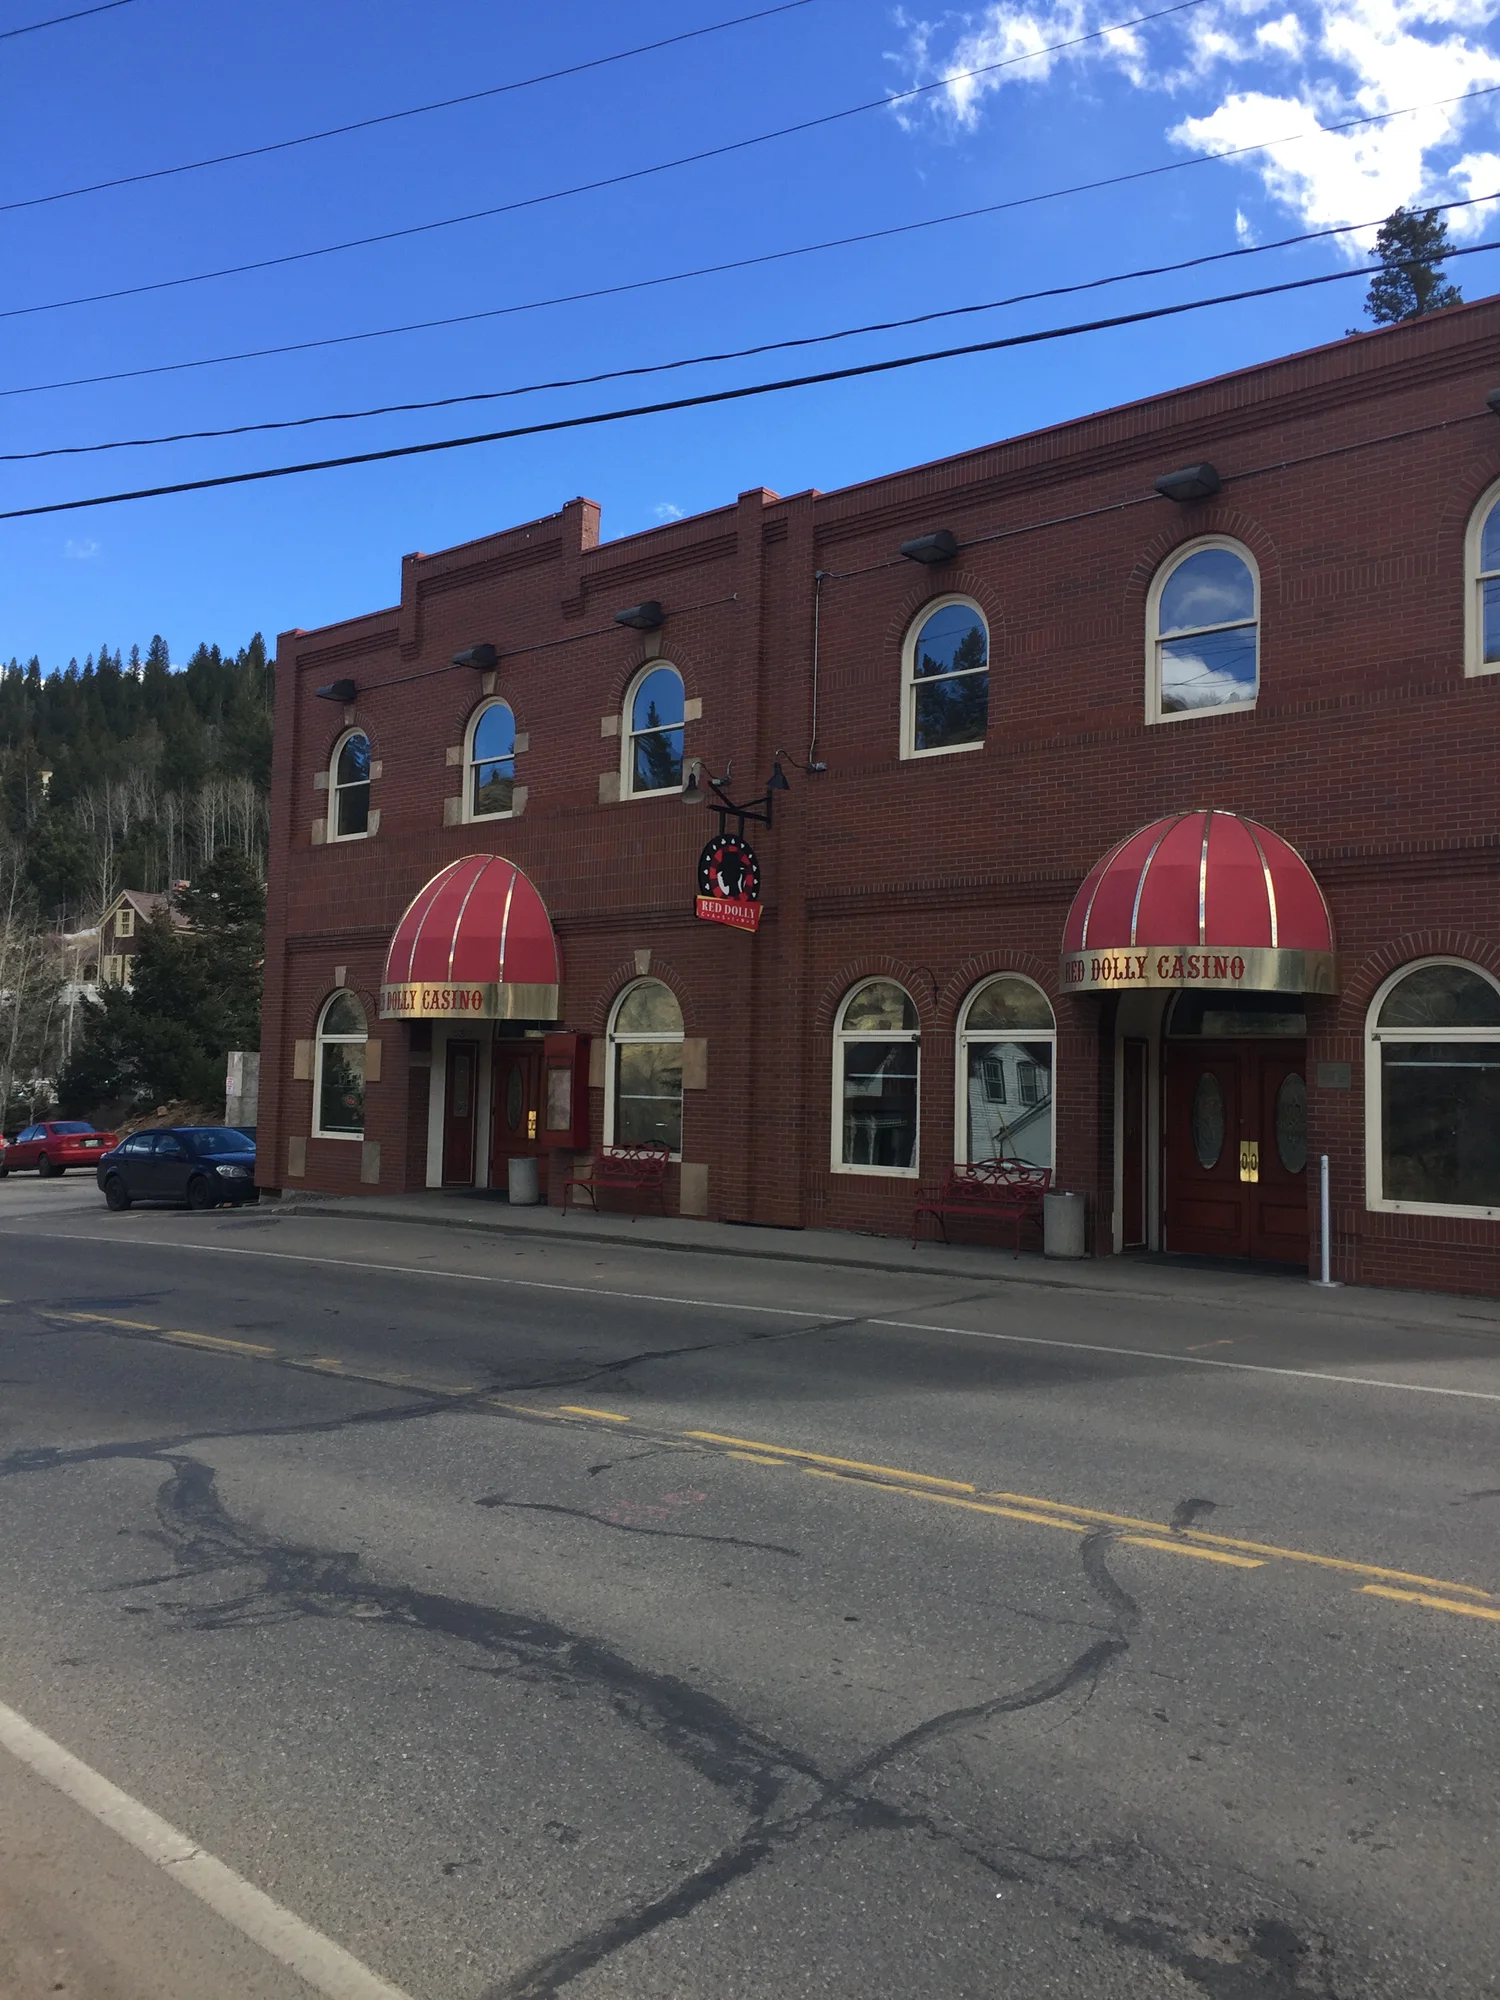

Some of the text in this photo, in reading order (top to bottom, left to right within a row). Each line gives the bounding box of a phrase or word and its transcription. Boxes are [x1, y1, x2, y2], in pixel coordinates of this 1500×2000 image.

[702, 901, 755, 919] RED DOLLY
[1065, 954, 1246, 984] RED DOLLY CASINO
[386, 990, 418, 1011] DOLLY
[421, 989, 483, 1011] CASINO
